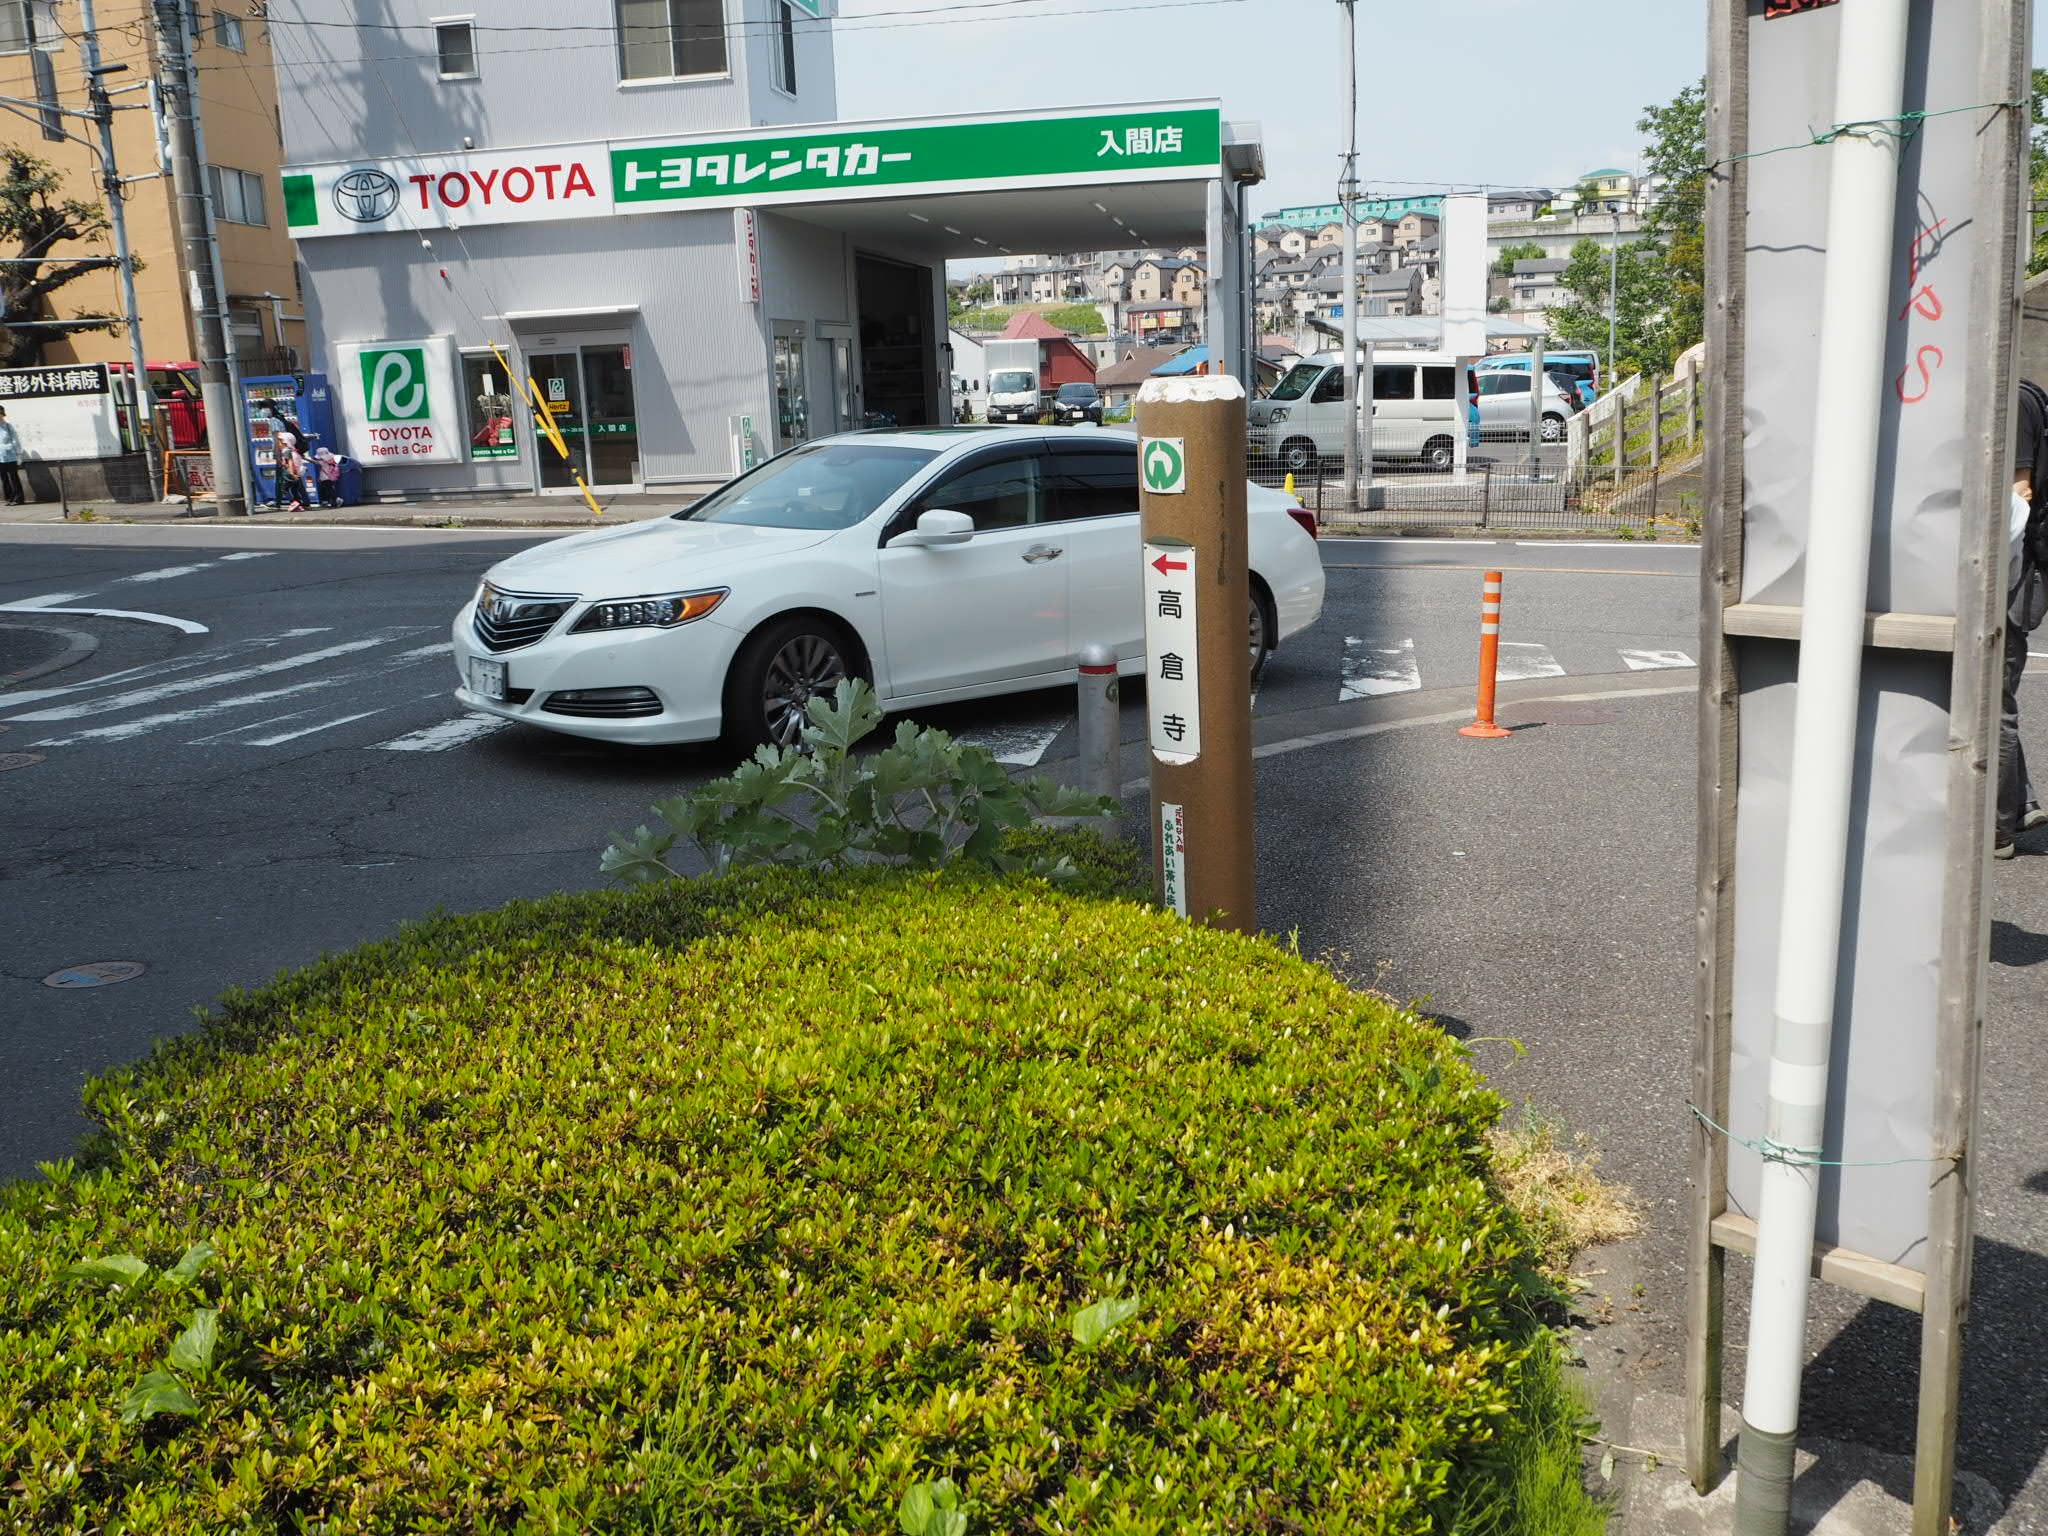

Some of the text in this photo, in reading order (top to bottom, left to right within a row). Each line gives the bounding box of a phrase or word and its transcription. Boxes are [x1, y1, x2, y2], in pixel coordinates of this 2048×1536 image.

[1096, 125, 1184, 157] 入間店
[624, 143, 912, 192] トヨタレンタカー
[408, 162, 596, 210] TOYOTA
[0, 370, 100, 396] 整形外科病院
[369, 426, 432, 441] TOYOTA
[598, 423, 627, 433] 入間店
[371, 442, 433, 456] Rent a Car
[1157, 589, 1186, 742] 高倉寺
